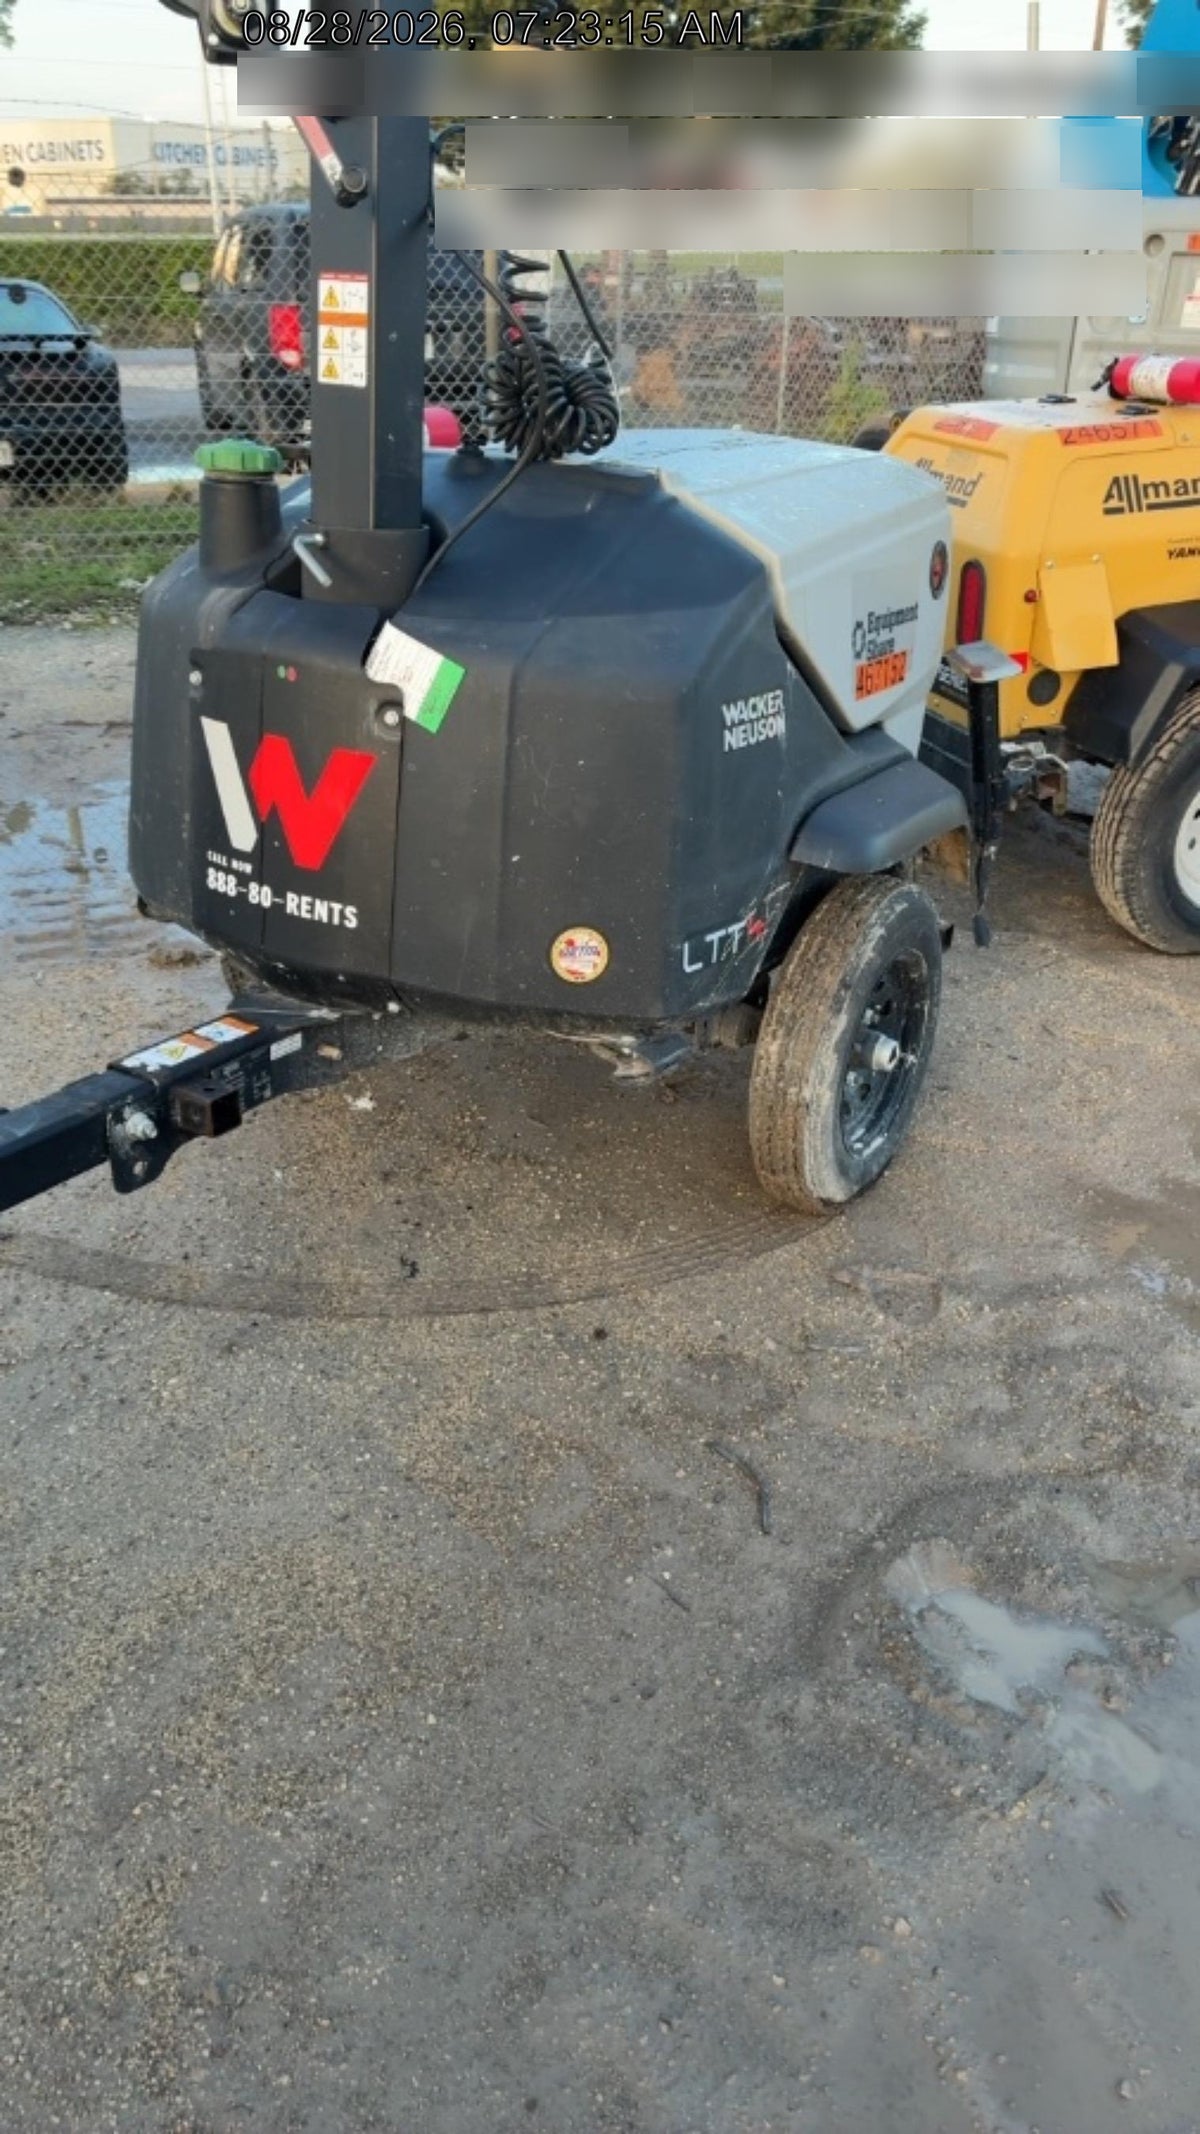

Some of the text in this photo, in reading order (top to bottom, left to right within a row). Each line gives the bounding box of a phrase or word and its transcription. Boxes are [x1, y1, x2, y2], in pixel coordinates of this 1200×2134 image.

[25, 138, 105, 164] CABINETS
[213, 144, 279, 168] CBINES
[866, 601, 919, 637] Equipment
[866, 637, 895, 660] Share
[721, 688, 786, 726] WACKER
[722, 715, 786, 752] NEUSON
[206, 850, 253, 875] CALL NOW
[206, 866, 358, 929] 888-80-RENTS
